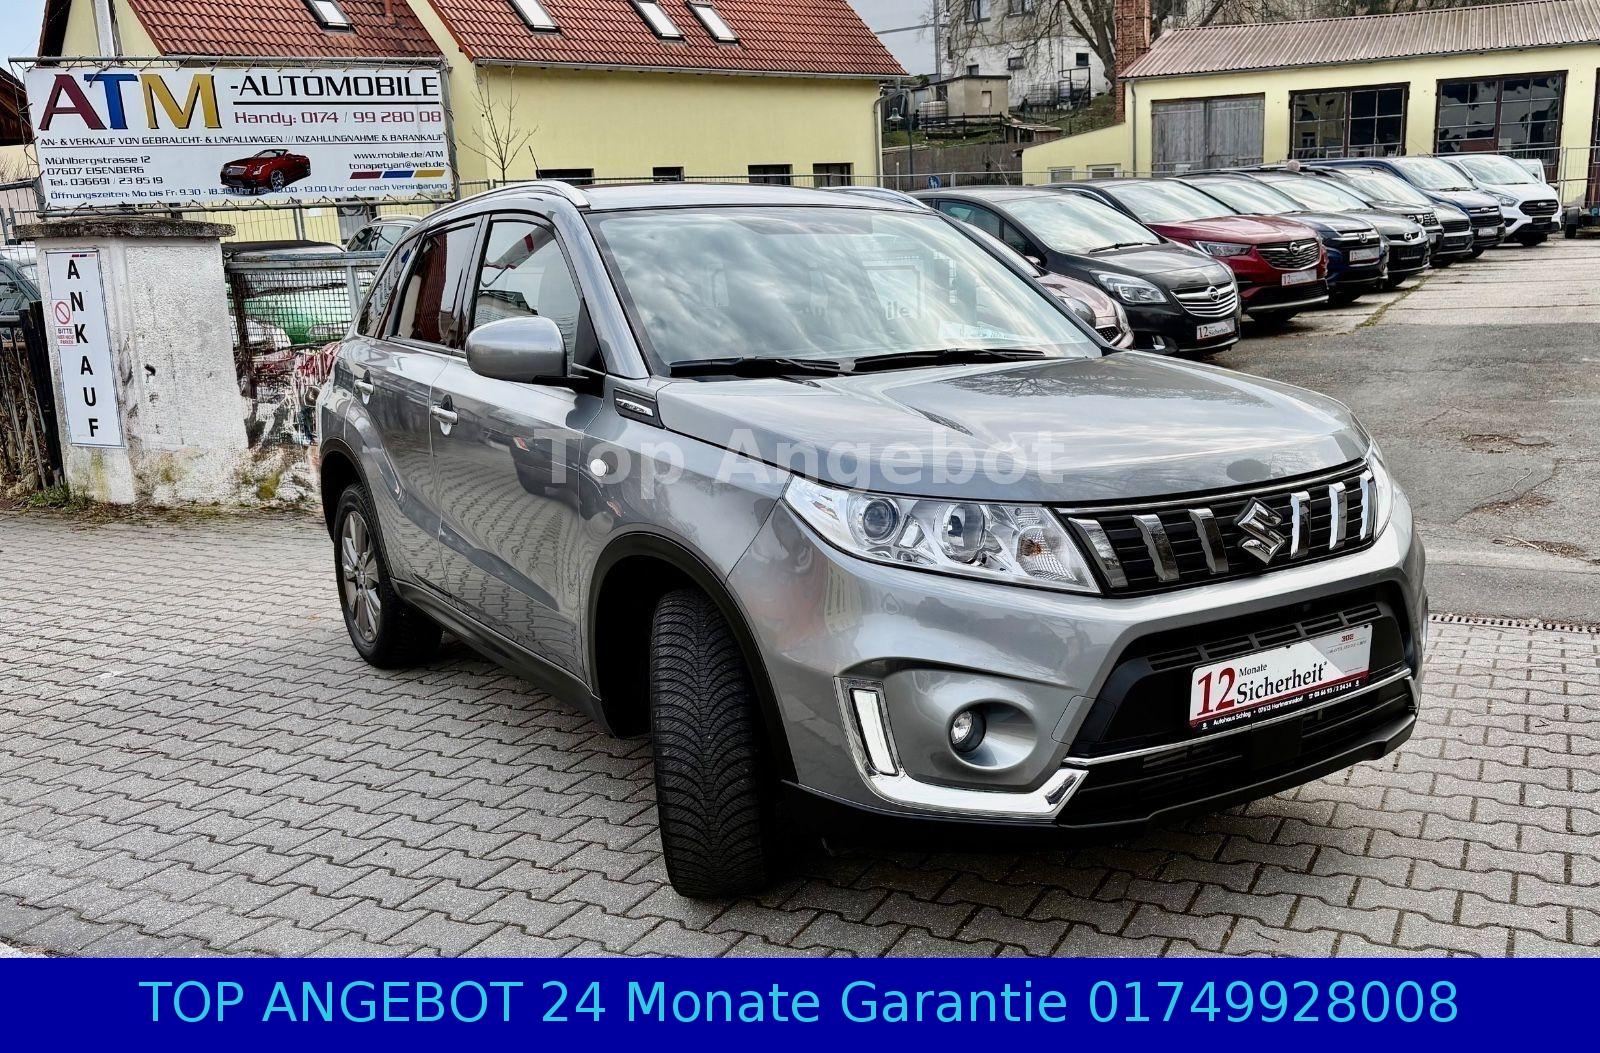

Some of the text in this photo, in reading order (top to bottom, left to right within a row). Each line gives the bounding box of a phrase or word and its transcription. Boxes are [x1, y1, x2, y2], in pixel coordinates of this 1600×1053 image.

[230, 75, 439, 97] -AUTOMOBILE
[38, 73, 222, 130] ATM
[234, 111, 297, 126] Handy:
[301, 111, 339, 124] 0174
[353, 111, 376, 123] 99
[380, 111, 415, 123] 280
[419, 111, 441, 123] 08
[40, 138, 58, 146] AN-
[60, 138, 68, 146] &
[69, 137, 116, 146] VERKAUF
[118, 137, 139, 145] VON
[142, 136, 203, 145] GEBRAUCHT-
[205, 136, 213, 144] &
[214, 135, 283, 144] UNFALLWAGEN
[381, 134, 389, 142] &
[390, 133, 444, 142] BARANKAUF
[45, 155, 151, 165] Mühlbergstrasse 12
[353, 150, 444, 159] www.mobile.de/ATM
[47, 166, 145, 176] 07607 EISENBERG
[349, 160, 445, 170] tonapetyan@web.de
[70, 177, 110, 186] 036691
[119, 177, 134, 185] 23
[135, 176, 150, 185] 85
[152, 176, 163, 184] 19
[132, 190, 147, 198] Mo
[149, 189, 164, 197] bis
[328, 184, 345, 192] Uhr
[346, 184, 367, 192] oder
[368, 183, 390, 191] nach
[391, 182, 448, 192] Vereinbarung
[67, 259, 98, 437] ANKAUF
[1239, 663, 1268, 678] Monate
[1197, 667, 1236, 717] 12
